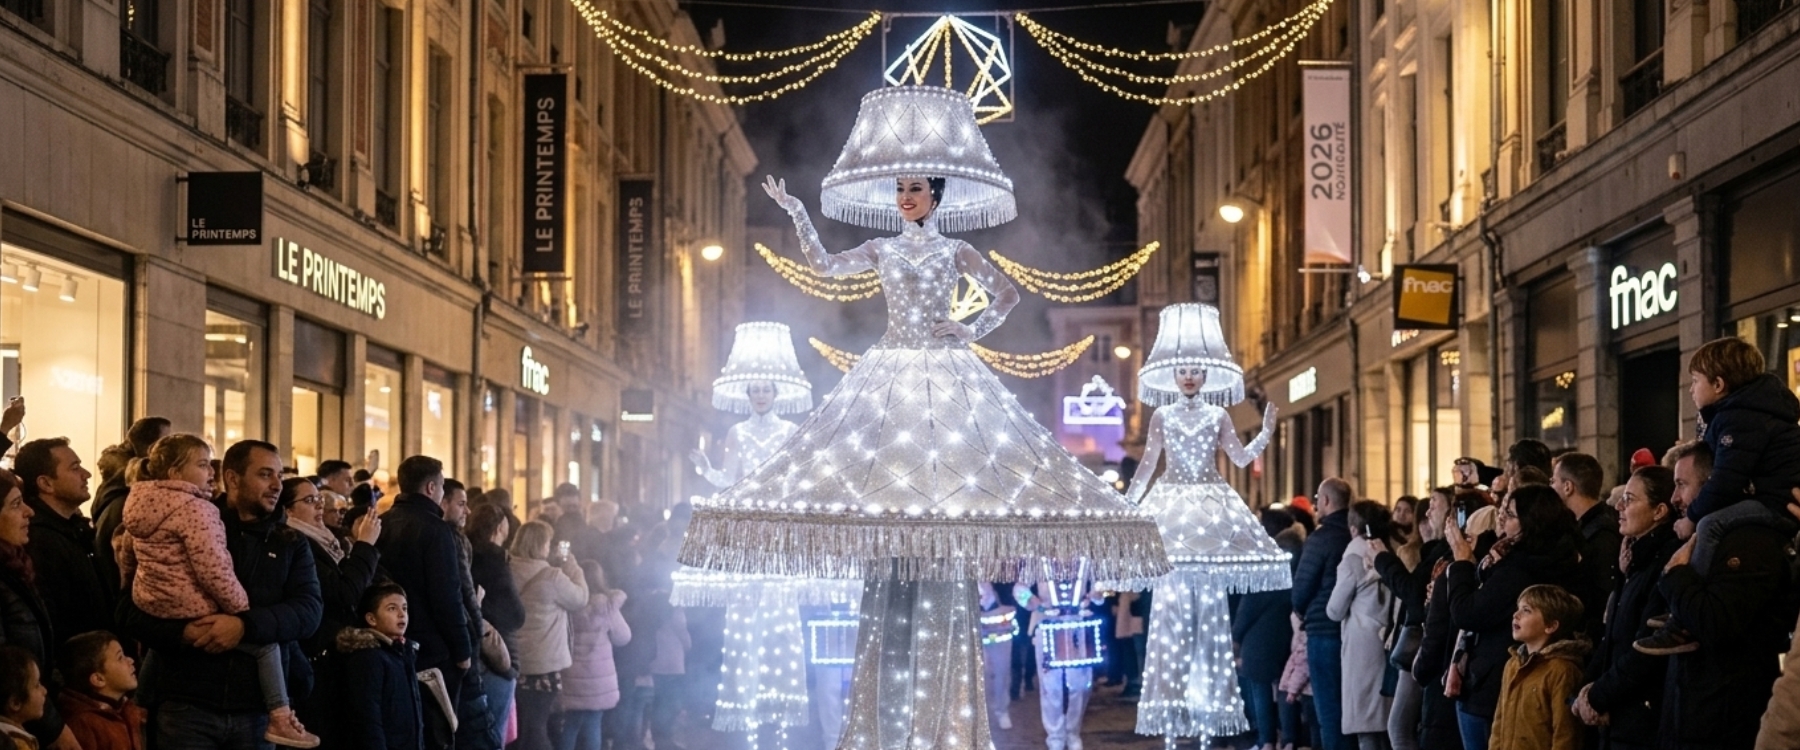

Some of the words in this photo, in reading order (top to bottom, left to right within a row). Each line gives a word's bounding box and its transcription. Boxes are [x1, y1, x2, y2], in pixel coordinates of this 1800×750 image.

[536, 97, 555, 221] PRINTEMPS
[1310, 123, 1333, 200] 2026
[191, 218, 206, 229] LE
[191, 228, 257, 240] PRINTEMPS
[536, 227, 554, 252] LE
[628, 197, 644, 294] PRINTEMPS
[278, 237, 299, 285] LE
[302, 247, 386, 320] PRINTEMPS
[1402, 276, 1454, 294] fnac
[1609, 262, 1678, 330] fnac
[628, 299, 643, 319] LE
[522, 345, 550, 396] fnac
